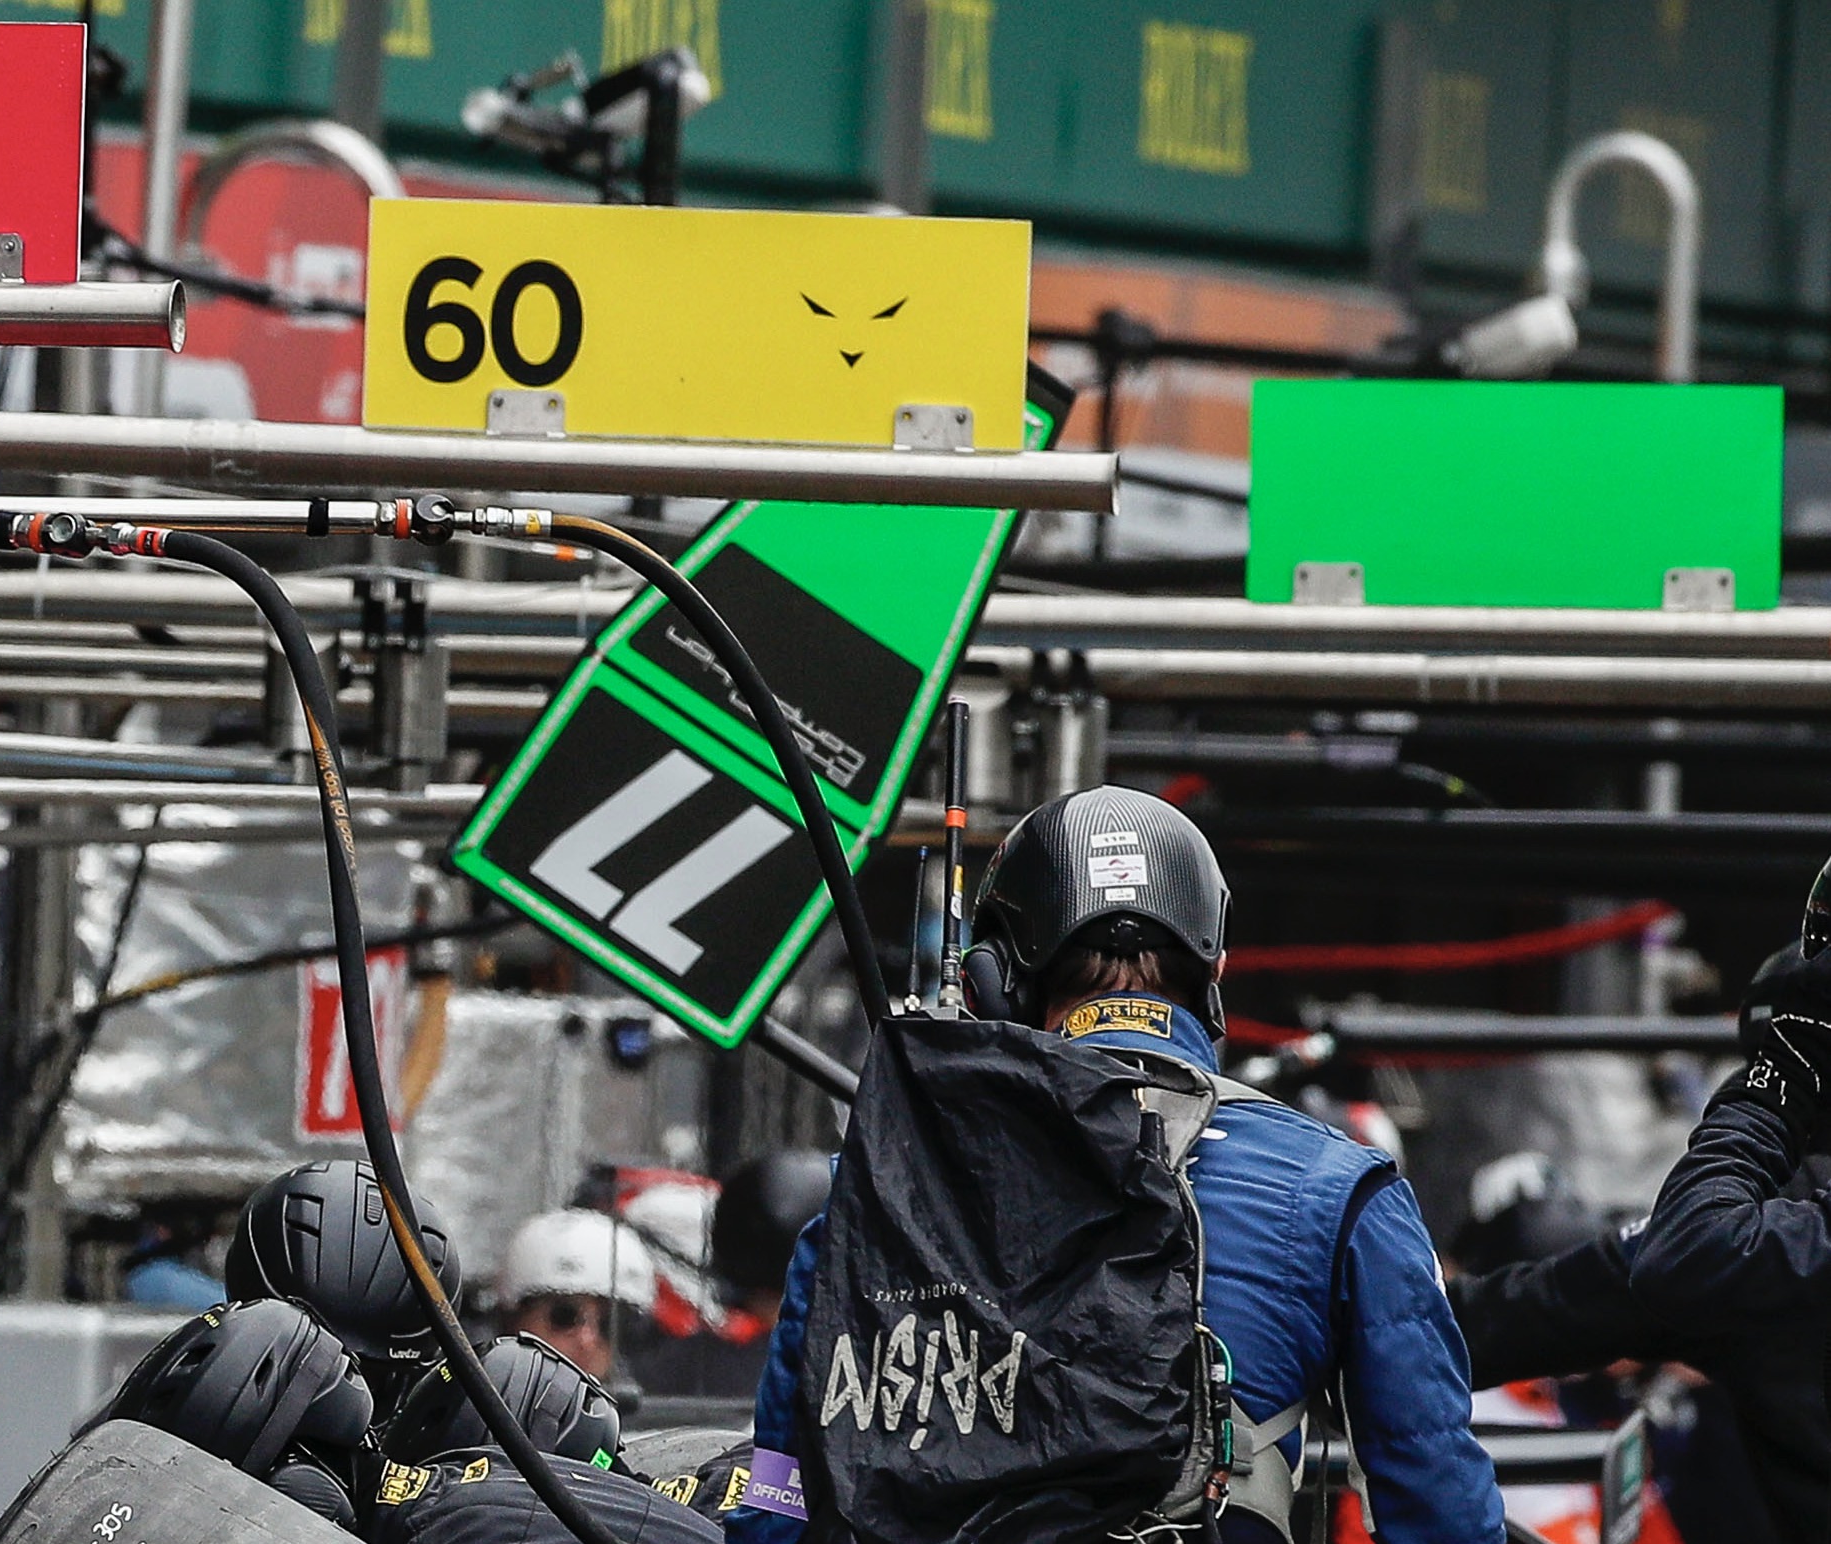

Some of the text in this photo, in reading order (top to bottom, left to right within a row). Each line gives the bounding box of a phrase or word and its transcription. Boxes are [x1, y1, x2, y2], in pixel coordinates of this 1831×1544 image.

[403, 257, 583, 387] 60
[529, 749, 795, 978] 77
[752, 1482, 807, 1510] OFFICIA
